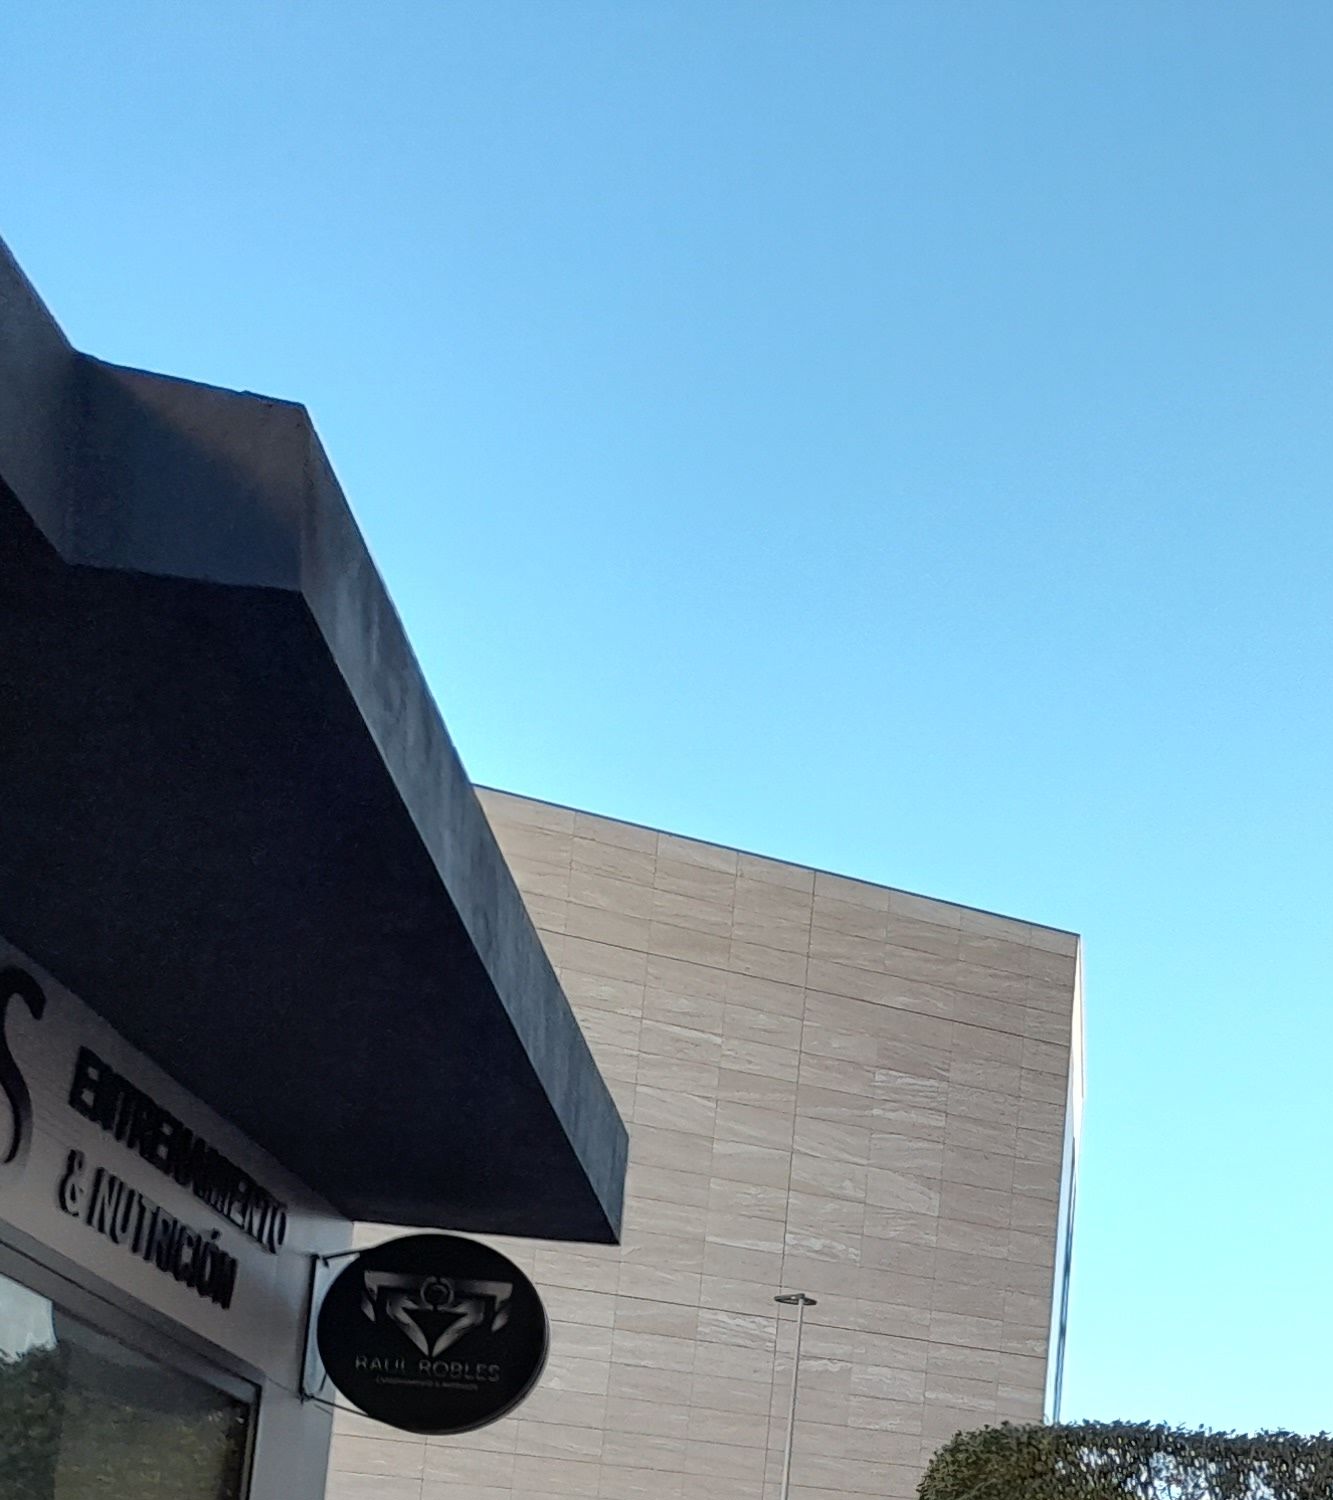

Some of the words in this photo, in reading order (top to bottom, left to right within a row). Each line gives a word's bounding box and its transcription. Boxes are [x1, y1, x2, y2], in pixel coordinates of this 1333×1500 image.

[59, 1149, 84, 1217] &
[86, 1166, 237, 1310] NUTRICIÓN
[418, 1359, 500, 1382] ROBLES
